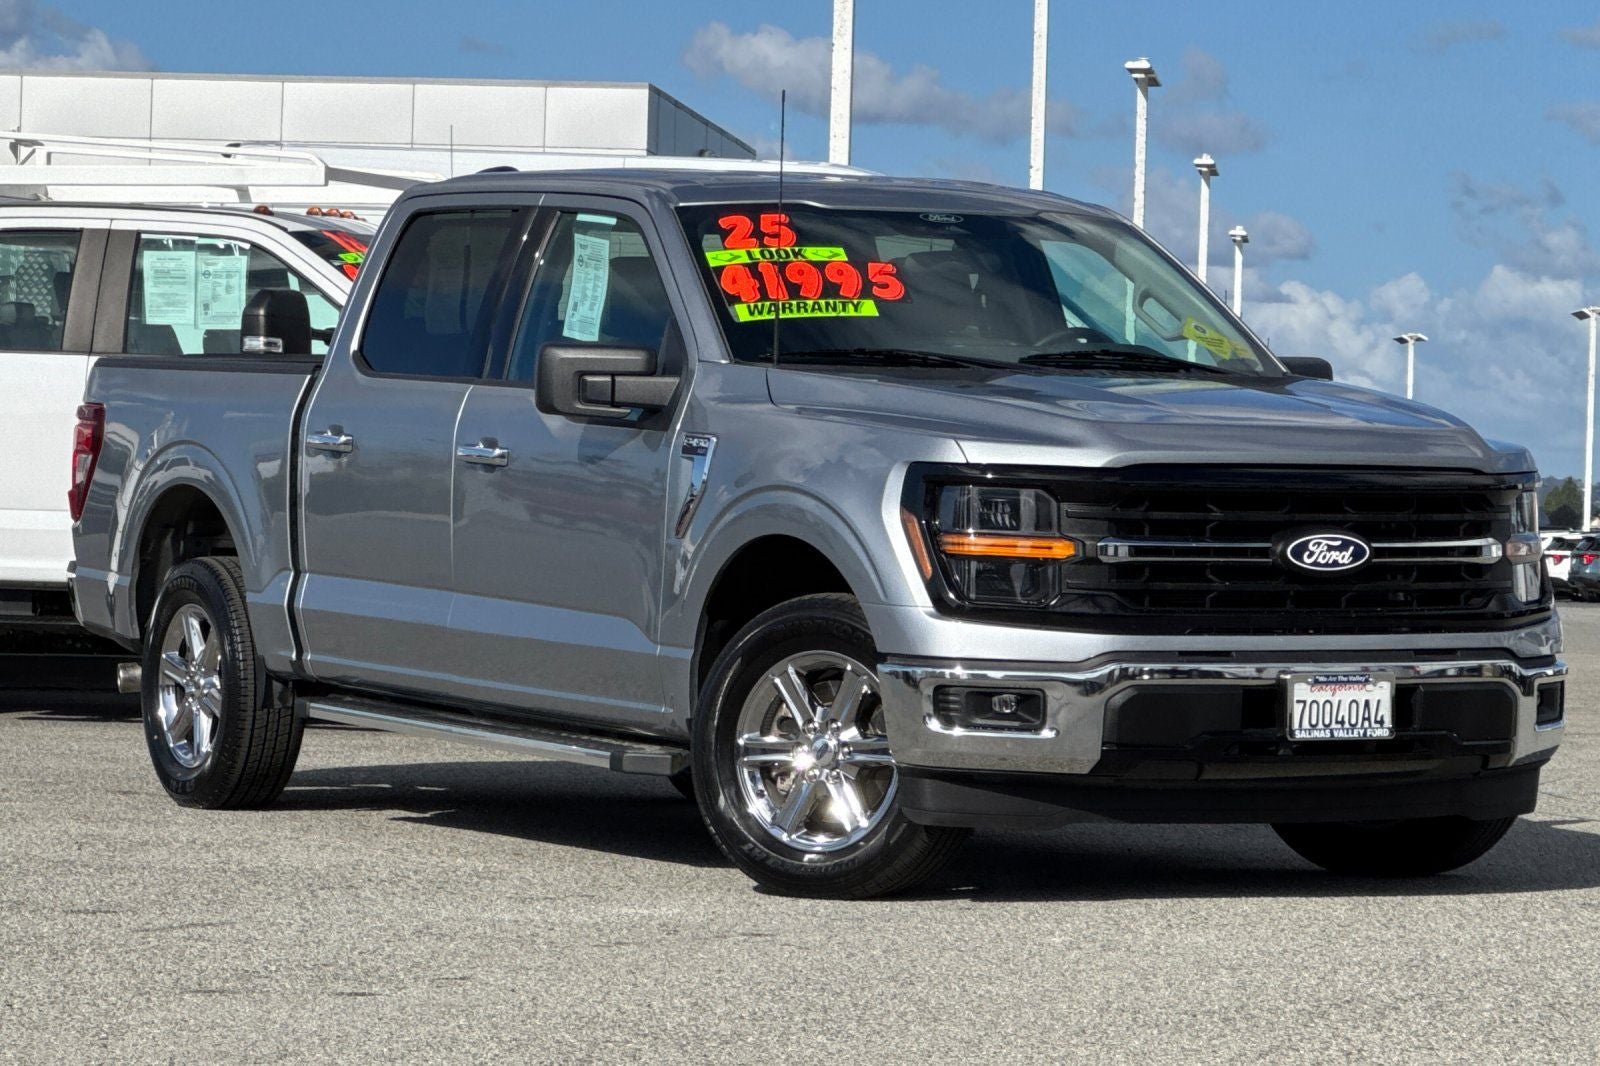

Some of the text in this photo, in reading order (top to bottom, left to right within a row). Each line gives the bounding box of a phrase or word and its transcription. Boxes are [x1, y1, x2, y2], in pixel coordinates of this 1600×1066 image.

[718, 213, 797, 249] 25
[745, 248, 808, 261] LOOK
[720, 261, 905, 303] 41995
[747, 300, 863, 317] WARRANTY
[1303, 539, 1354, 564] Ford
[1295, 699, 1385, 729] 70040A4
[1295, 728, 1389, 739] SALINAS VALLEY FORD
